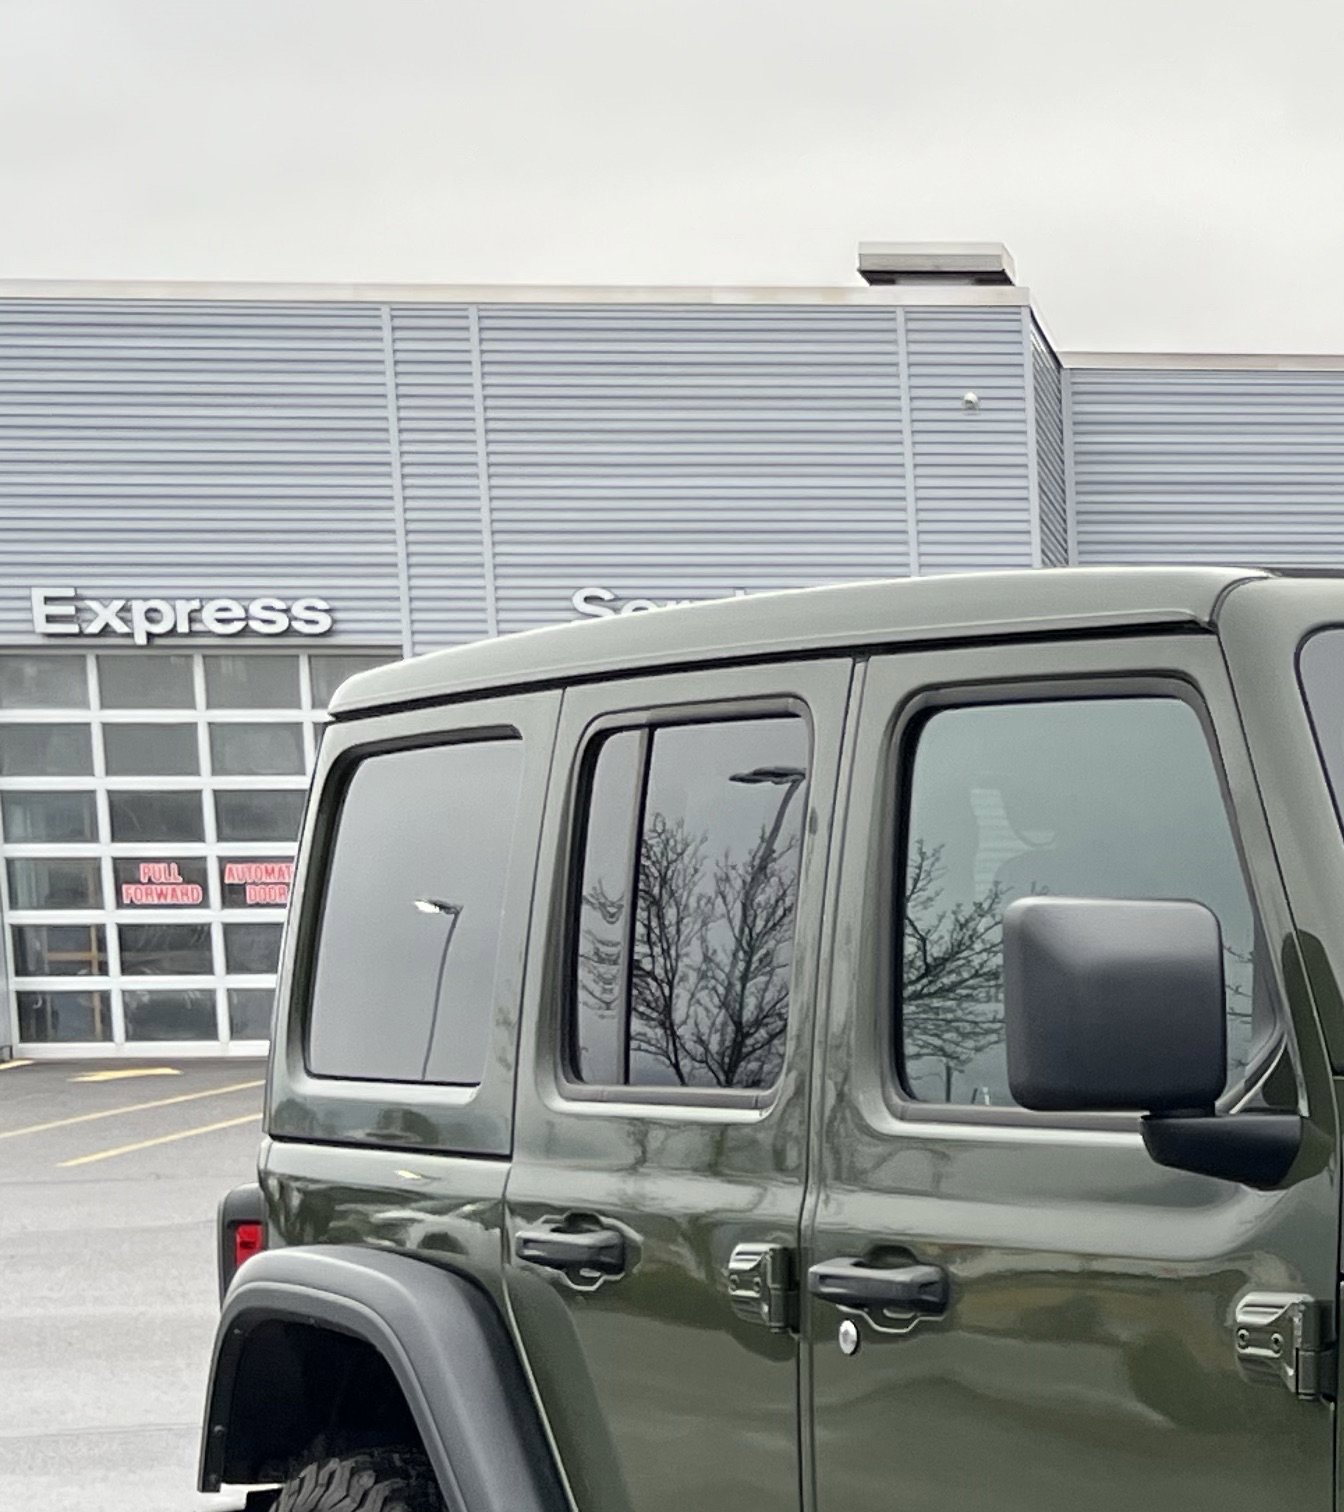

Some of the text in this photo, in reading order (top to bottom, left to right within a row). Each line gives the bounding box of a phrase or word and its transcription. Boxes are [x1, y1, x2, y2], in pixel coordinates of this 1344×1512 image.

[31, 587, 333, 645] Express
[140, 863, 183, 883] PULL
[122, 884, 203, 904] FORWARD
